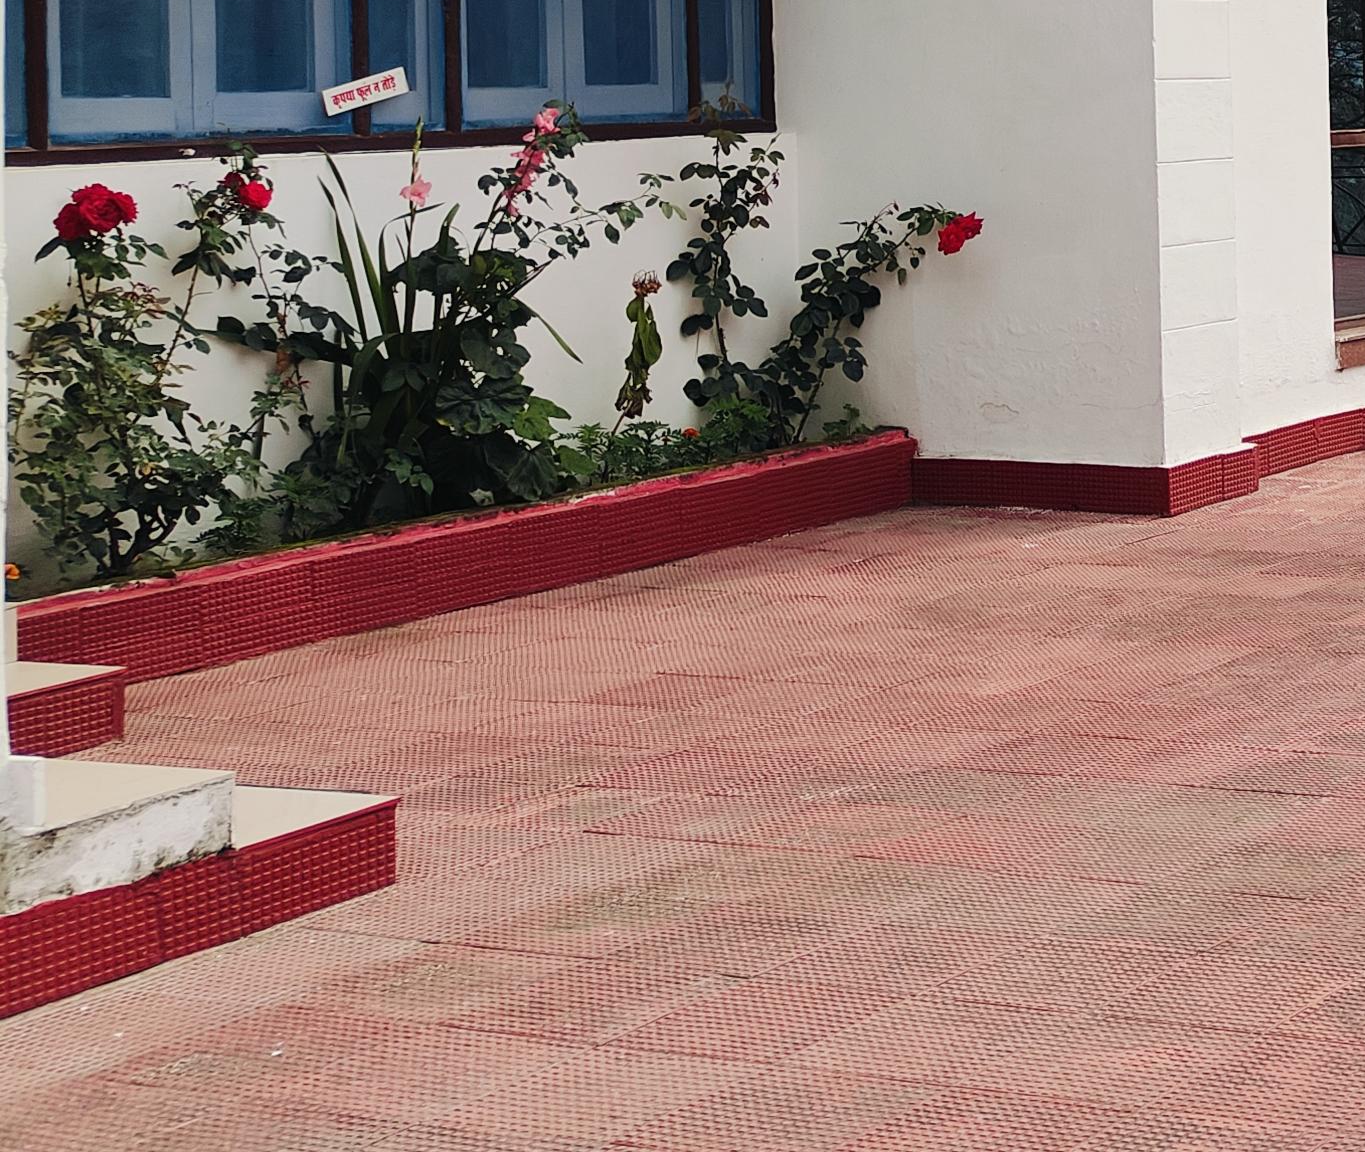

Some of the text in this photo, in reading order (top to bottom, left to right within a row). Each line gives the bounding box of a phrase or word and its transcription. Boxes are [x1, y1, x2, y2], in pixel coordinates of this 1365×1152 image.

[331, 89, 356, 109] कृपया
[356, 84, 372, 102] फूल
[372, 82, 380, 93] न
